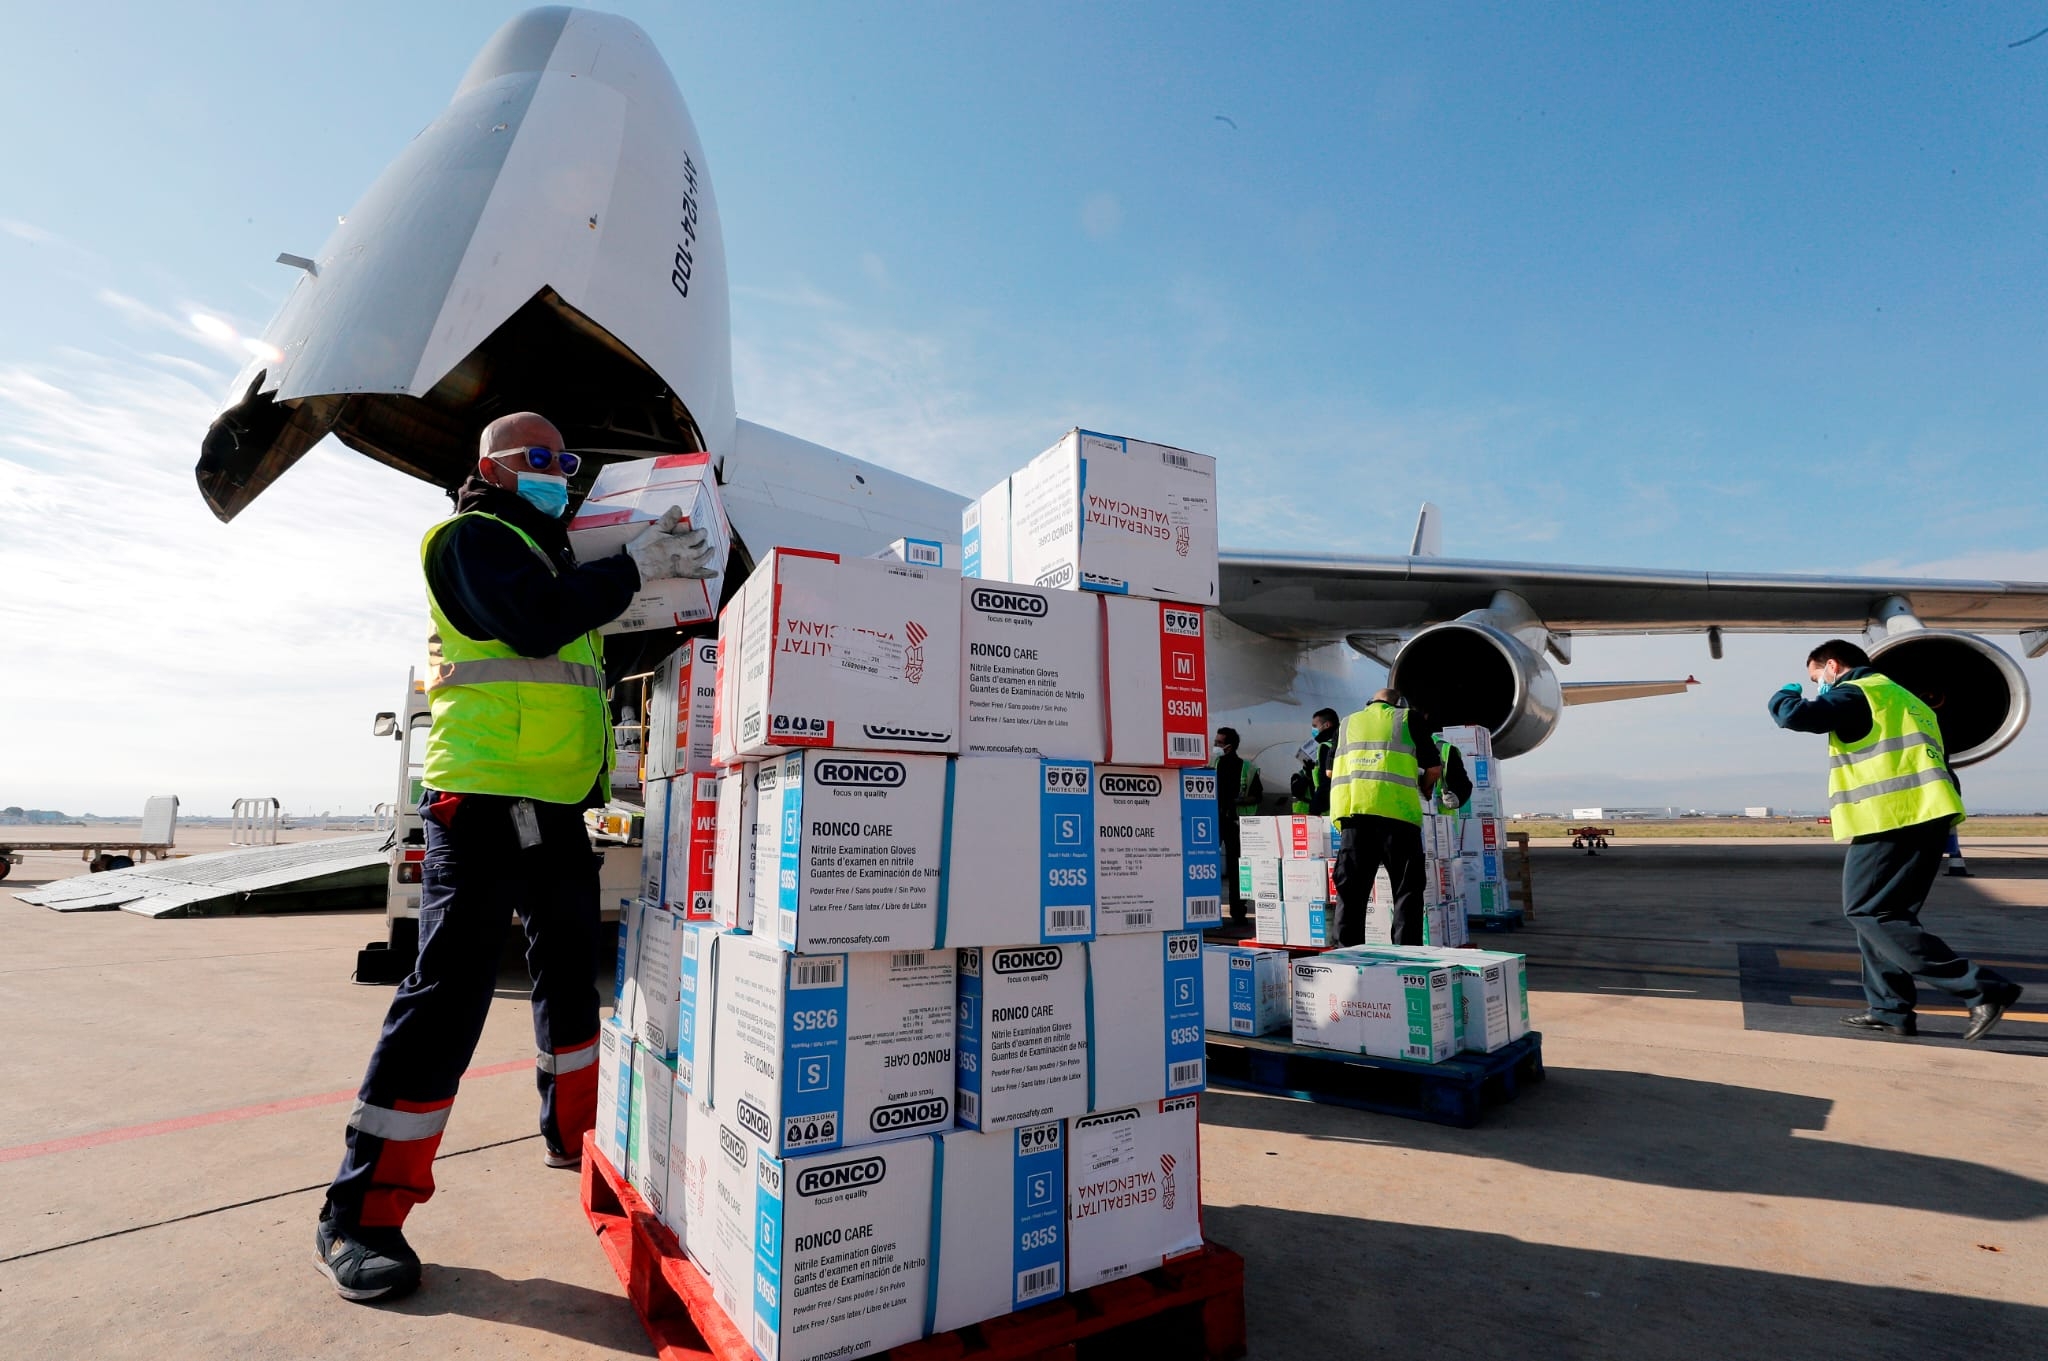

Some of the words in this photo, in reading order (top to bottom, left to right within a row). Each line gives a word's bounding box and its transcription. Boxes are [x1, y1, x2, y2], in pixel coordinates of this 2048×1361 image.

[1089, 494, 1170, 525] VALENCIANA
[1086, 510, 1170, 540] GENERALITAT
[978, 593, 1042, 613] RONCO
[1013, 618, 1033, 626] quality
[970, 643, 1011, 658] RONCO
[1014, 648, 1038, 660] CARE
[970, 664, 992, 672] Nitrile
[993, 665, 1035, 676] Examination
[1037, 669, 1058, 678] Gloves
[1178, 658, 1190, 674] M
[970, 674, 990, 682] Gants
[992, 675, 1026, 685] d'examen
[1038, 679, 1056, 688] nitrile
[970, 684, 999, 694] Guantes
[1001, 686, 1010, 695] de
[1012, 687, 1054, 697] Examinación
[1056, 690, 1063, 698] de
[1066, 691, 1085, 699] Nitrilo
[1168, 700, 1202, 717] 935M
[970, 745, 1038, 754] www.roncosafety.com
[823, 765, 899, 782] RONCO
[1106, 778, 1156, 792] RONCO
[833, 789, 851, 797] focus
[864, 790, 887, 799] quality
[787, 817, 793, 836] S
[812, 822, 860, 837] RONCO
[864, 825, 892, 837] CARE
[1062, 820, 1073, 838] S
[1100, 826, 1132, 838] RONCO
[1135, 828, 1155, 838] CARE
[1198, 822, 1206, 838] S
[811, 845, 836, 854] Nitrile
[839, 845, 888, 855] Examination
[890, 846, 916, 854] Gloves
[811, 857, 835, 866] Gants
[837, 857, 877, 866] d'examen
[891, 857, 913, 865] nitrile
[810, 869, 844, 879] Guantes
[848, 869, 857, 878] de
[860, 869, 909, 878] Examinación
[912, 869, 921, 878] de
[1049, 868, 1087, 886] 935S
[1189, 864, 1216, 880] 935S
[810, 887, 834, 895] Powder
[836, 887, 849, 895] Free
[872, 887, 893, 895] poudre
[899, 886, 908, 894] Sin
[910, 886, 926, 894] Polvo
[810, 904, 827, 912] Latex
[848, 903, 863, 911] Sans
[865, 903, 879, 911] latex
[885, 903, 899, 911] Libre
[809, 935, 889, 945] www.roncosafety.com
[999, 950, 1057, 969] RONCO
[1008, 975, 1021, 983] focus
[1031, 974, 1049, 982] quality
[1239, 981, 1245, 990] S
[1181, 984, 1188, 1000] S
[961, 1002, 968, 1020] S
[992, 1006, 1029, 1022] RONCO
[1031, 1005, 1054, 1018] CARE
[1233, 1002, 1251, 1011] 935S
[1341, 1001, 1392, 1010] GENERALITAT
[1412, 1002, 1417, 1011] L
[793, 1008, 838, 1031] 935S
[1342, 1010, 1391, 1019] VALENCIANA
[992, 1029, 1011, 1039] Nitrile
[1013, 1024, 1051, 1038] Examination
[1052, 1022, 1072, 1032] Gloves
[1171, 1025, 1199, 1045] 935S
[1410, 1025, 1426, 1036] 35L
[992, 1040, 1010, 1051] Gants
[1012, 1036, 1043, 1048] d'examen
[1044, 1035, 1052, 1044] en
[1053, 1033, 1070, 1042] nitrile
[913, 1048, 951, 1065] RONCO
[992, 1050, 1018, 1062] Guantes
[1020, 1048, 1028, 1058] de
[1029, 1044, 1068, 1057] Examinación
[1069, 1042, 1077, 1051] de
[756, 1056, 774, 1080] RONCO
[884, 1055, 910, 1068] CARE
[959, 1050, 976, 1072] 35S
[807, 1064, 821, 1084] S
[888, 1091, 908, 1101] quality
[739, 1106, 769, 1138] RONCO
[787, 1113, 835, 1125] PROTECTION
[877, 1103, 942, 1127] RONCO
[991, 1106, 1054, 1124] www.roncosafety.com
[721, 1131, 745, 1165] RONCO
[1021, 1143, 1058, 1154] PROTECTION
[804, 1162, 879, 1191] RONCO
[1078, 1171, 1156, 1198] VALENCIANA
[1035, 1179, 1045, 1198] S
[815, 1195, 833, 1206] focus
[845, 1189, 868, 1201] quality
[1076, 1188, 1156, 1219] GENERALITAT
[764, 1222, 770, 1244] S
[795, 1228, 841, 1253] RONCO
[844, 1224, 873, 1242] CARE
[1021, 1225, 1057, 1251] 935S
[794, 1255, 818, 1272] Nitrile
[820, 1246, 869, 1266] Examination
[871, 1242, 896, 1256] Gloves
[794, 1269, 817, 1285] Gants
[819, 1262, 858, 1279] d'examen
[860, 1260, 870, 1270] en
[872, 1253, 894, 1267] nitrile
[794, 1281, 826, 1298] Guantes
[829, 1278, 839, 1290] de
[841, 1266, 890, 1287] Examinación
[892, 1264, 902, 1275] de
[903, 1257, 926, 1272] Nitrilo
[757, 1273, 776, 1308] 935S
[793, 1302, 816, 1316] Powder
[817, 1297, 831, 1309] Free
[837, 1293, 853, 1305] Sans
[854, 1288, 874, 1302] poudre
[880, 1284, 889, 1295] Sin
[890, 1281, 905, 1292] Polvo
[793, 1321, 810, 1334] Latex
[811, 1317, 825, 1329] Free
[830, 1312, 845, 1323] Sans
[846, 1308, 861, 1320] latex
[866, 1303, 881, 1314] Libre
[883, 1301, 891, 1311] de
